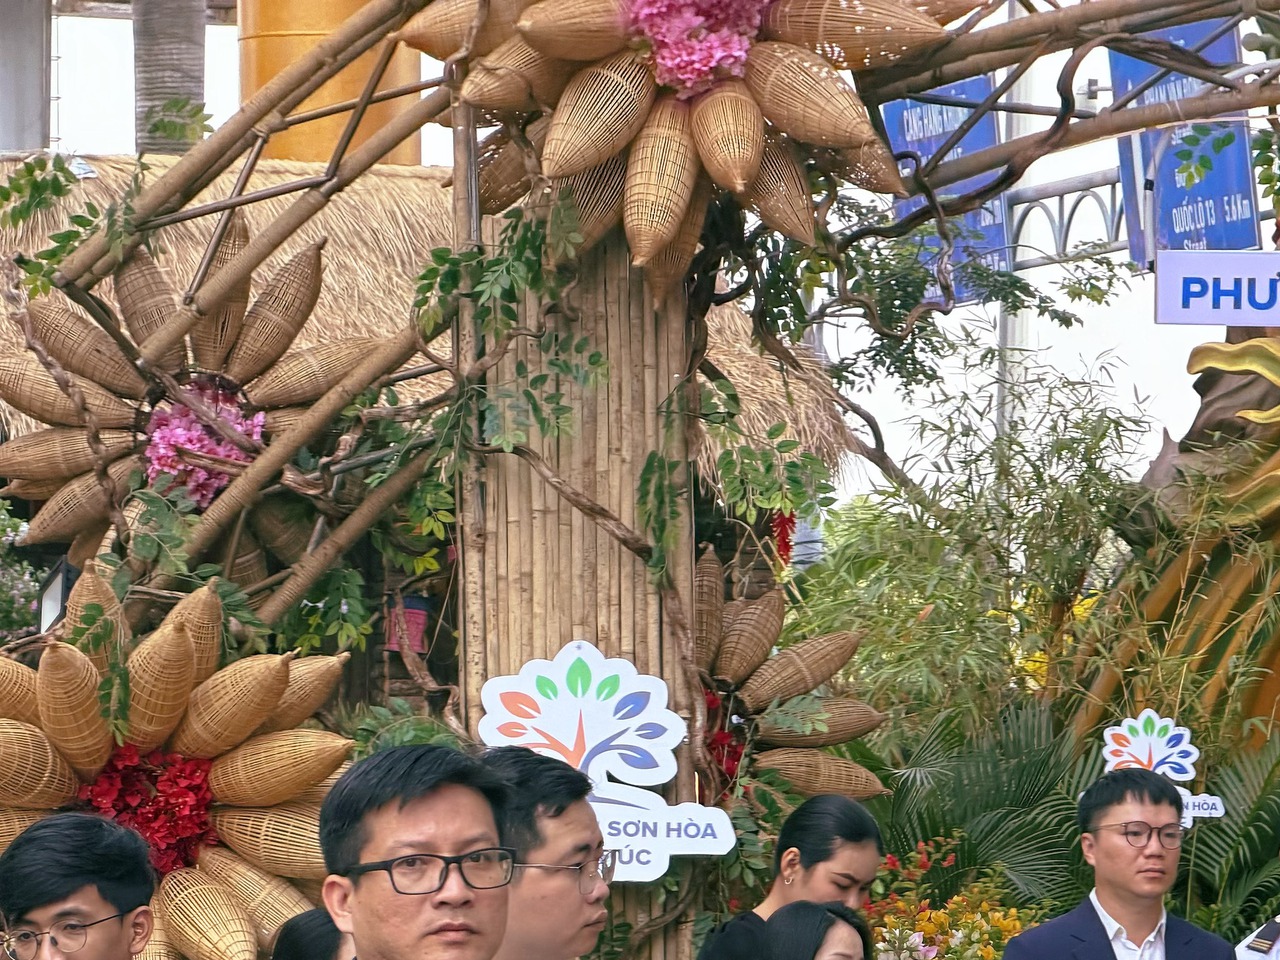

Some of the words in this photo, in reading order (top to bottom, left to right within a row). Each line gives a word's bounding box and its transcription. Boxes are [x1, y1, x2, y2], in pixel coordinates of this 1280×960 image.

[1205, 200, 1216, 226] 13
[607, 819, 658, 838] SƠN
[665, 818, 718, 839] HÒA
